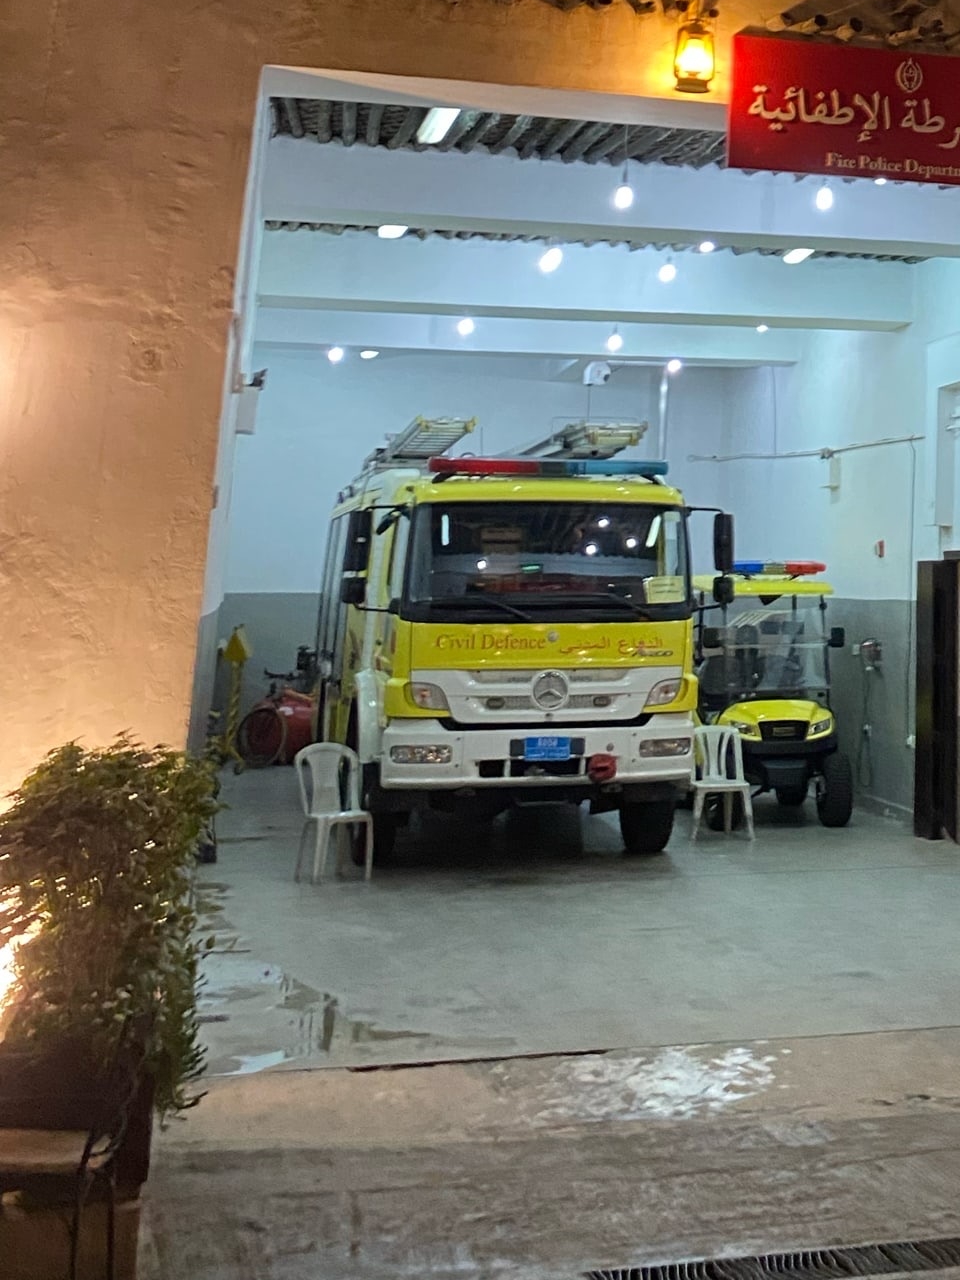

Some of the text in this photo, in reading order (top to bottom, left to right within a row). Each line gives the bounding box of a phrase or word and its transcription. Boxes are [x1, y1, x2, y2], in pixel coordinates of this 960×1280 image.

[748, 84, 891, 143] الإطفائية
[825, 151, 857, 170] Fire
[859, 153, 901, 173] Police
[435, 633, 547, 650] Civil Defence
